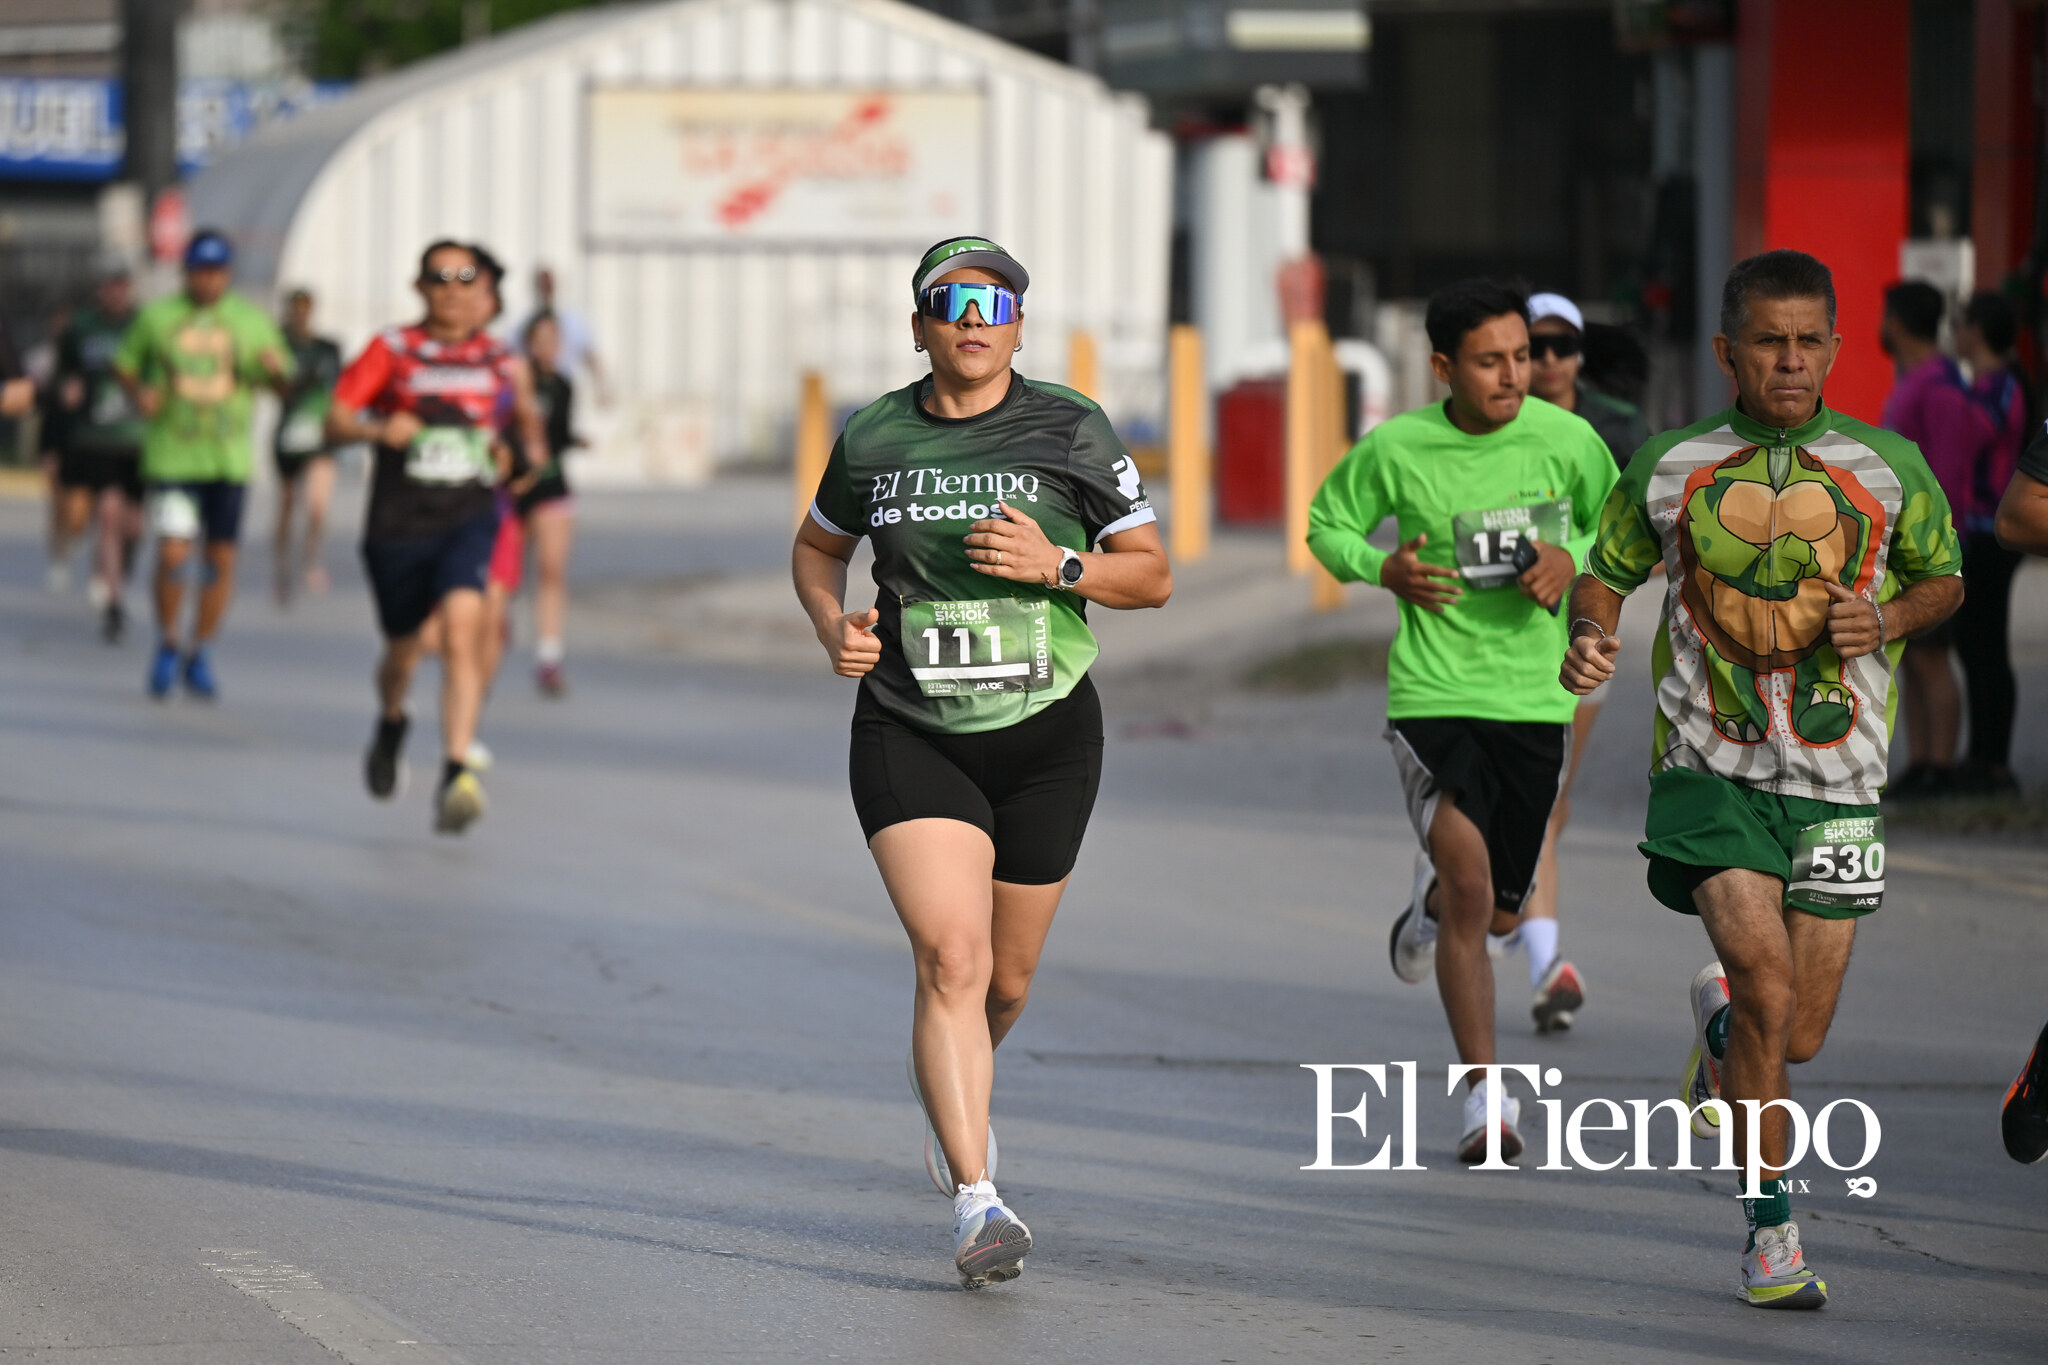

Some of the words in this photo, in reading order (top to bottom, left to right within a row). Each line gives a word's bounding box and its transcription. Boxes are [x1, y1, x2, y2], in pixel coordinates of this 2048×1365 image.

[871, 471, 901, 503] El
[907, 468, 1039, 501] Tiempo
[871, 506, 901, 528] de
[934, 601, 990, 610] CARRERA
[1030, 601, 1046, 610] 111
[922, 625, 1002, 665] 111
[1034, 616, 1049, 679] MEDALLA
[1824, 820, 1875, 828] CARRERA
[1809, 842, 1885, 881] 530
